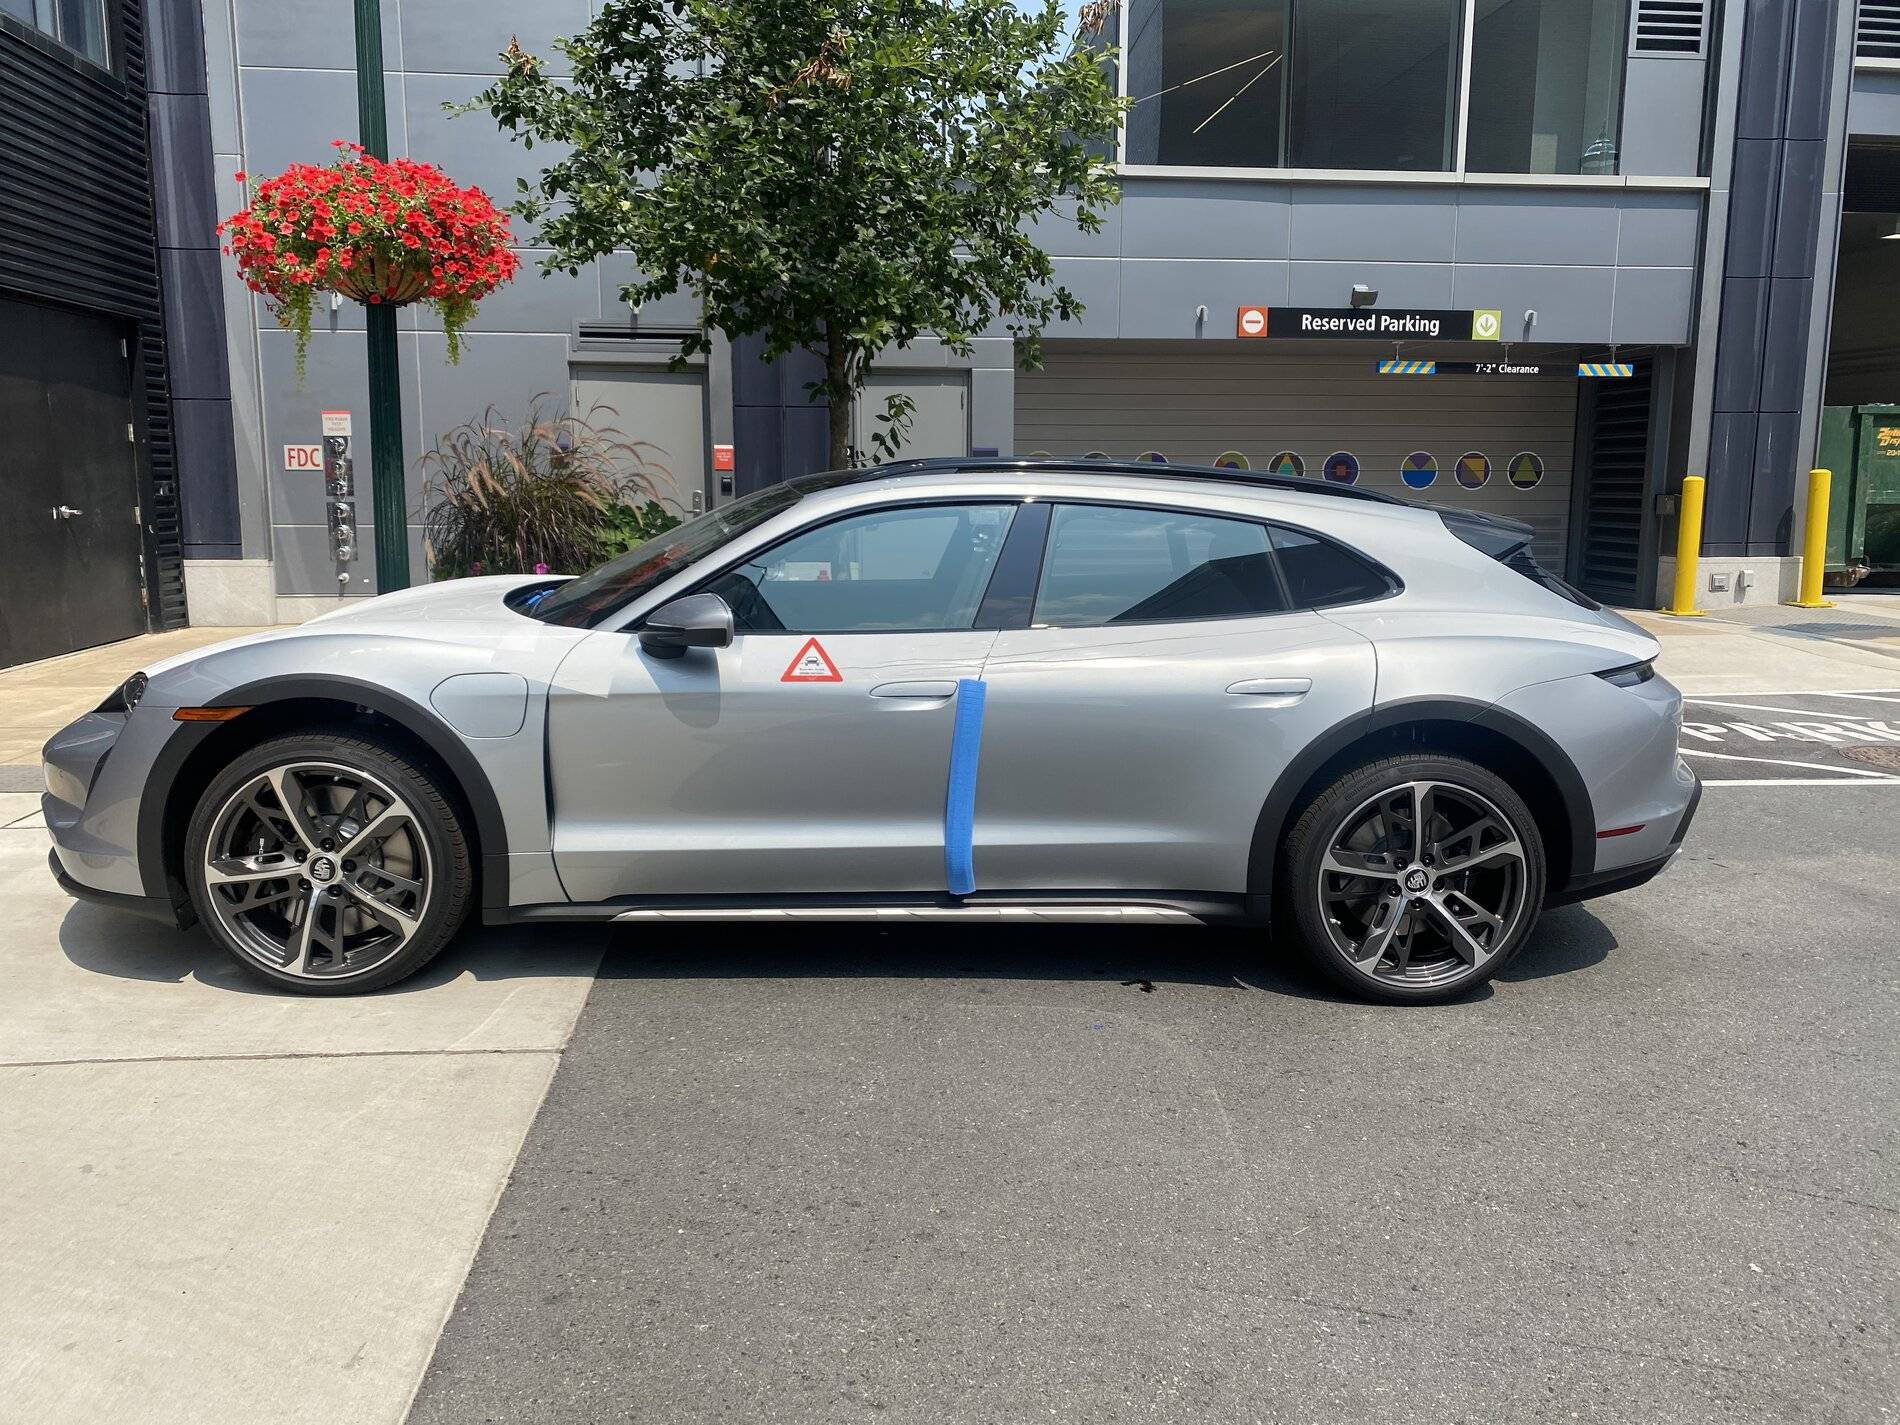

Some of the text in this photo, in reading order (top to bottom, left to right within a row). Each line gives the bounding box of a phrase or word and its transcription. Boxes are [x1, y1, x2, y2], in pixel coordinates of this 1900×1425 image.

[1301, 314, 1440, 336] Reserved Parking
[1499, 363, 1540, 374] Clearance
[287, 447, 321, 467] FDC
